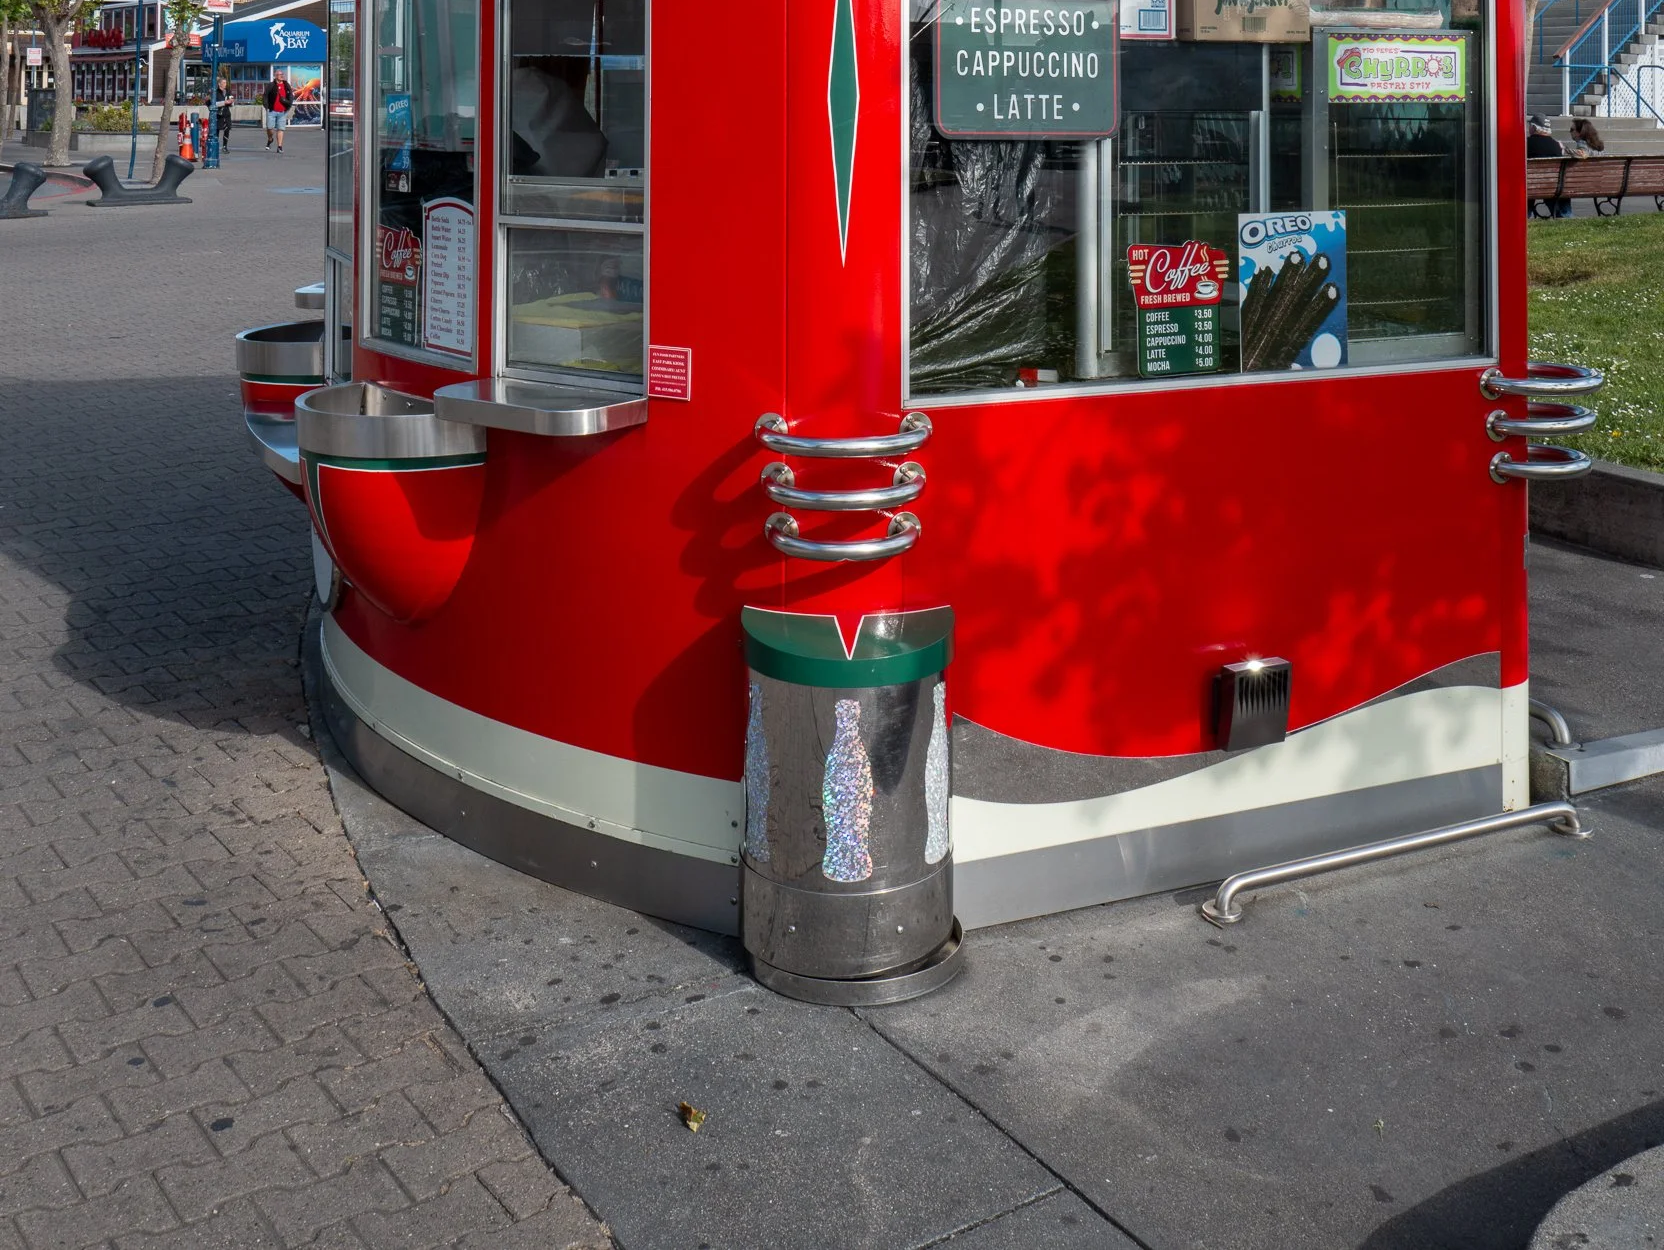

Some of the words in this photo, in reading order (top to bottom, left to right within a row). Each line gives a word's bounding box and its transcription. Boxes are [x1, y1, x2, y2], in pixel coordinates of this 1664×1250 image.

[971, 7, 1085, 36] ESPRESSO
[280, 30, 310, 38] AQUARIUM
[287, 37, 309, 49] BAY
[956, 50, 1098, 78] CAPPUCCINO
[1370, 82, 1406, 90] PASTRY
[388, 99, 409, 114] OREO
[994, 94, 1063, 120] LATTE
[1241, 215, 1312, 248] OREO
[383, 230, 412, 268] Coffee
[1266, 236, 1303, 254] Churros
[1132, 249, 1149, 261] HOT
[1145, 244, 1211, 293] Coffee
[1140, 294, 1162, 305] FRESH
[1163, 293, 1190, 303] BREWED
[1146, 312, 1170, 323] COFFEE
[1195, 309, 1212, 319] $3.50
[1146, 323, 1178, 335] ESPRESSO
[1195, 321, 1212, 331] $3.50
[1146, 335, 1186, 347] CAPPUCCINO
[1195, 333, 1213, 343] $4.00
[1147, 349, 1166, 360] LATTE
[1195, 345, 1213, 355] $4.00
[1147, 361, 1170, 372] MOCHA
[1195, 357, 1213, 367] $5.00
